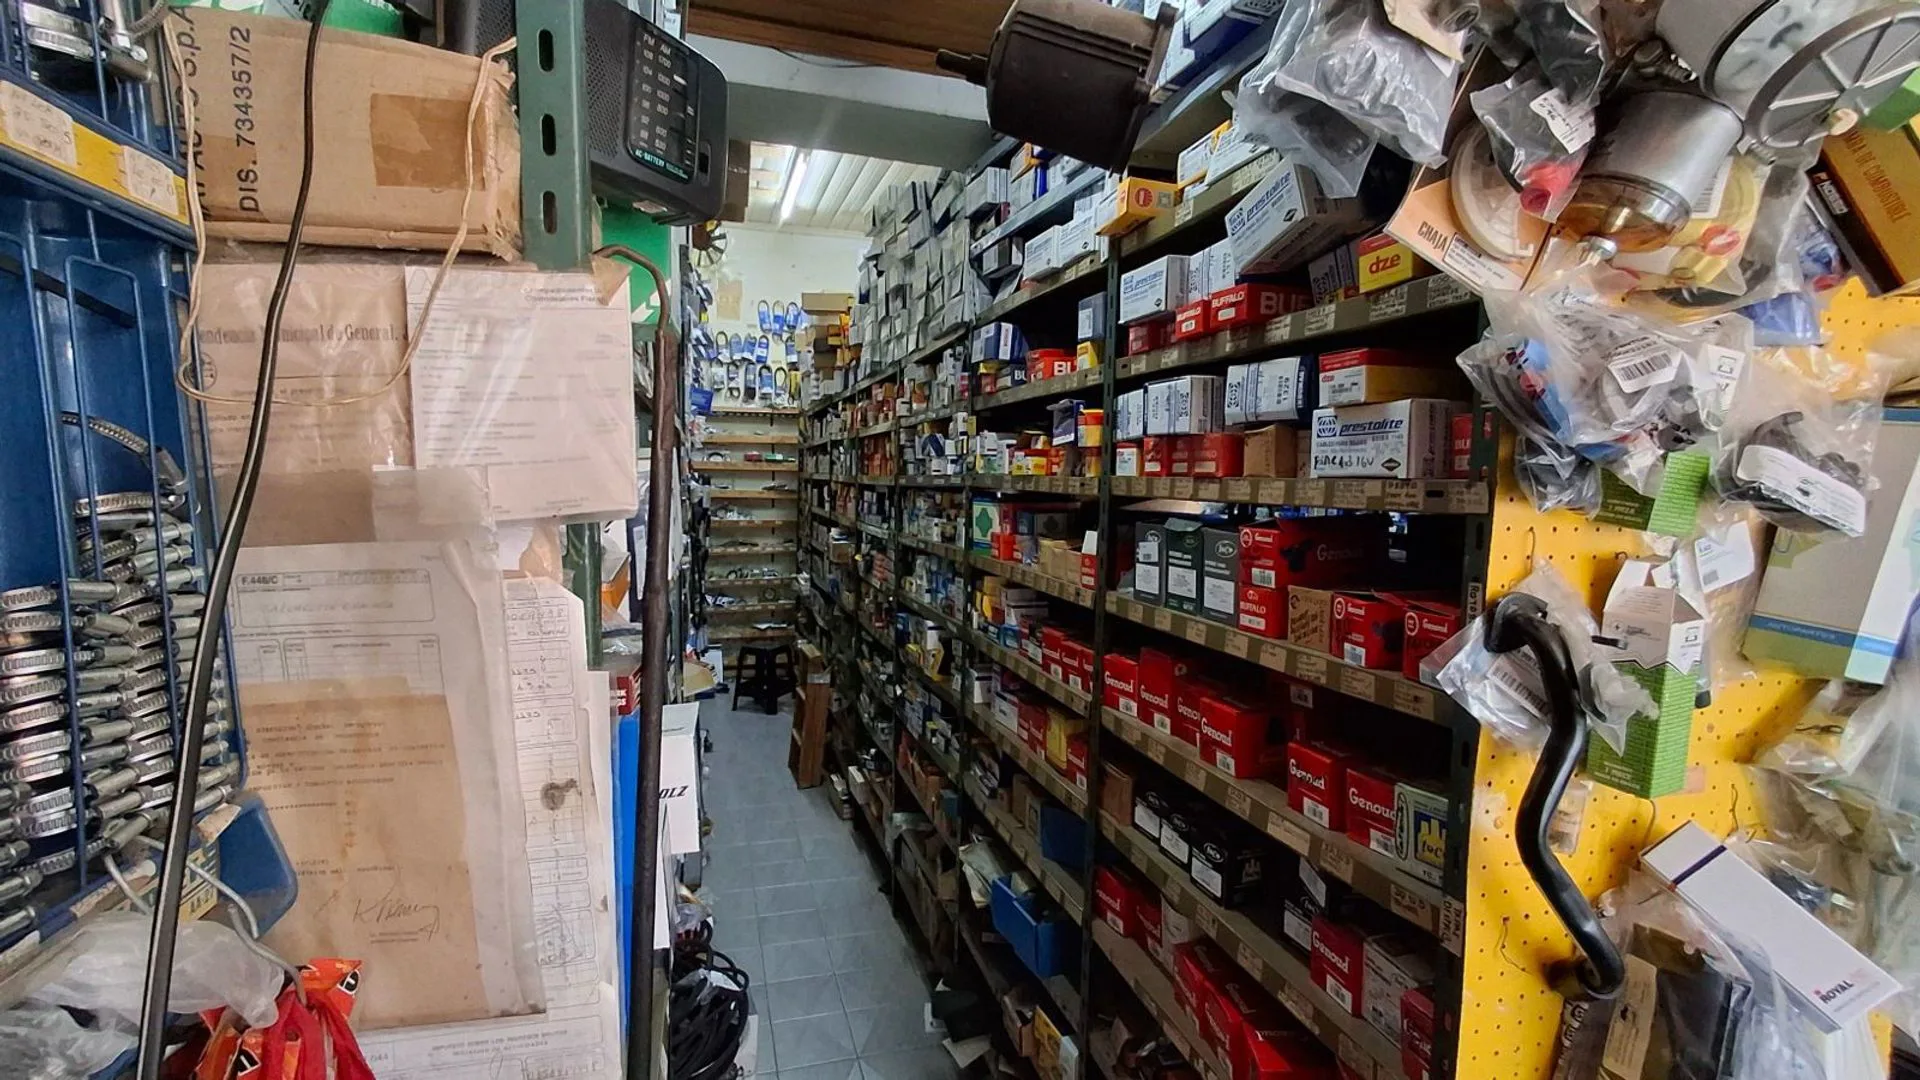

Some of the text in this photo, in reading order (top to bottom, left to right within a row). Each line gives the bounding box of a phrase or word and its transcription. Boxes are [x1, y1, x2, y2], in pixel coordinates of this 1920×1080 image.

[644, 34, 671, 56] FM AM
[231, 26, 259, 212] DIS. 734357/2
[1368, 253, 1401, 274] dze
[1211, 291, 1244, 308] BUFFALO
[1339, 418, 1404, 437] prestolite
[1104, 670, 1134, 694] Genoud
[1139, 685, 1169, 709] Genoud
[1178, 696, 1200, 721] Geno
[1201, 718, 1233, 747] Genoud
[1289, 758, 1326, 790] Genoud
[1311, 932, 1350, 972] Genoud
[1820, 981, 1855, 1004] ROYAL
